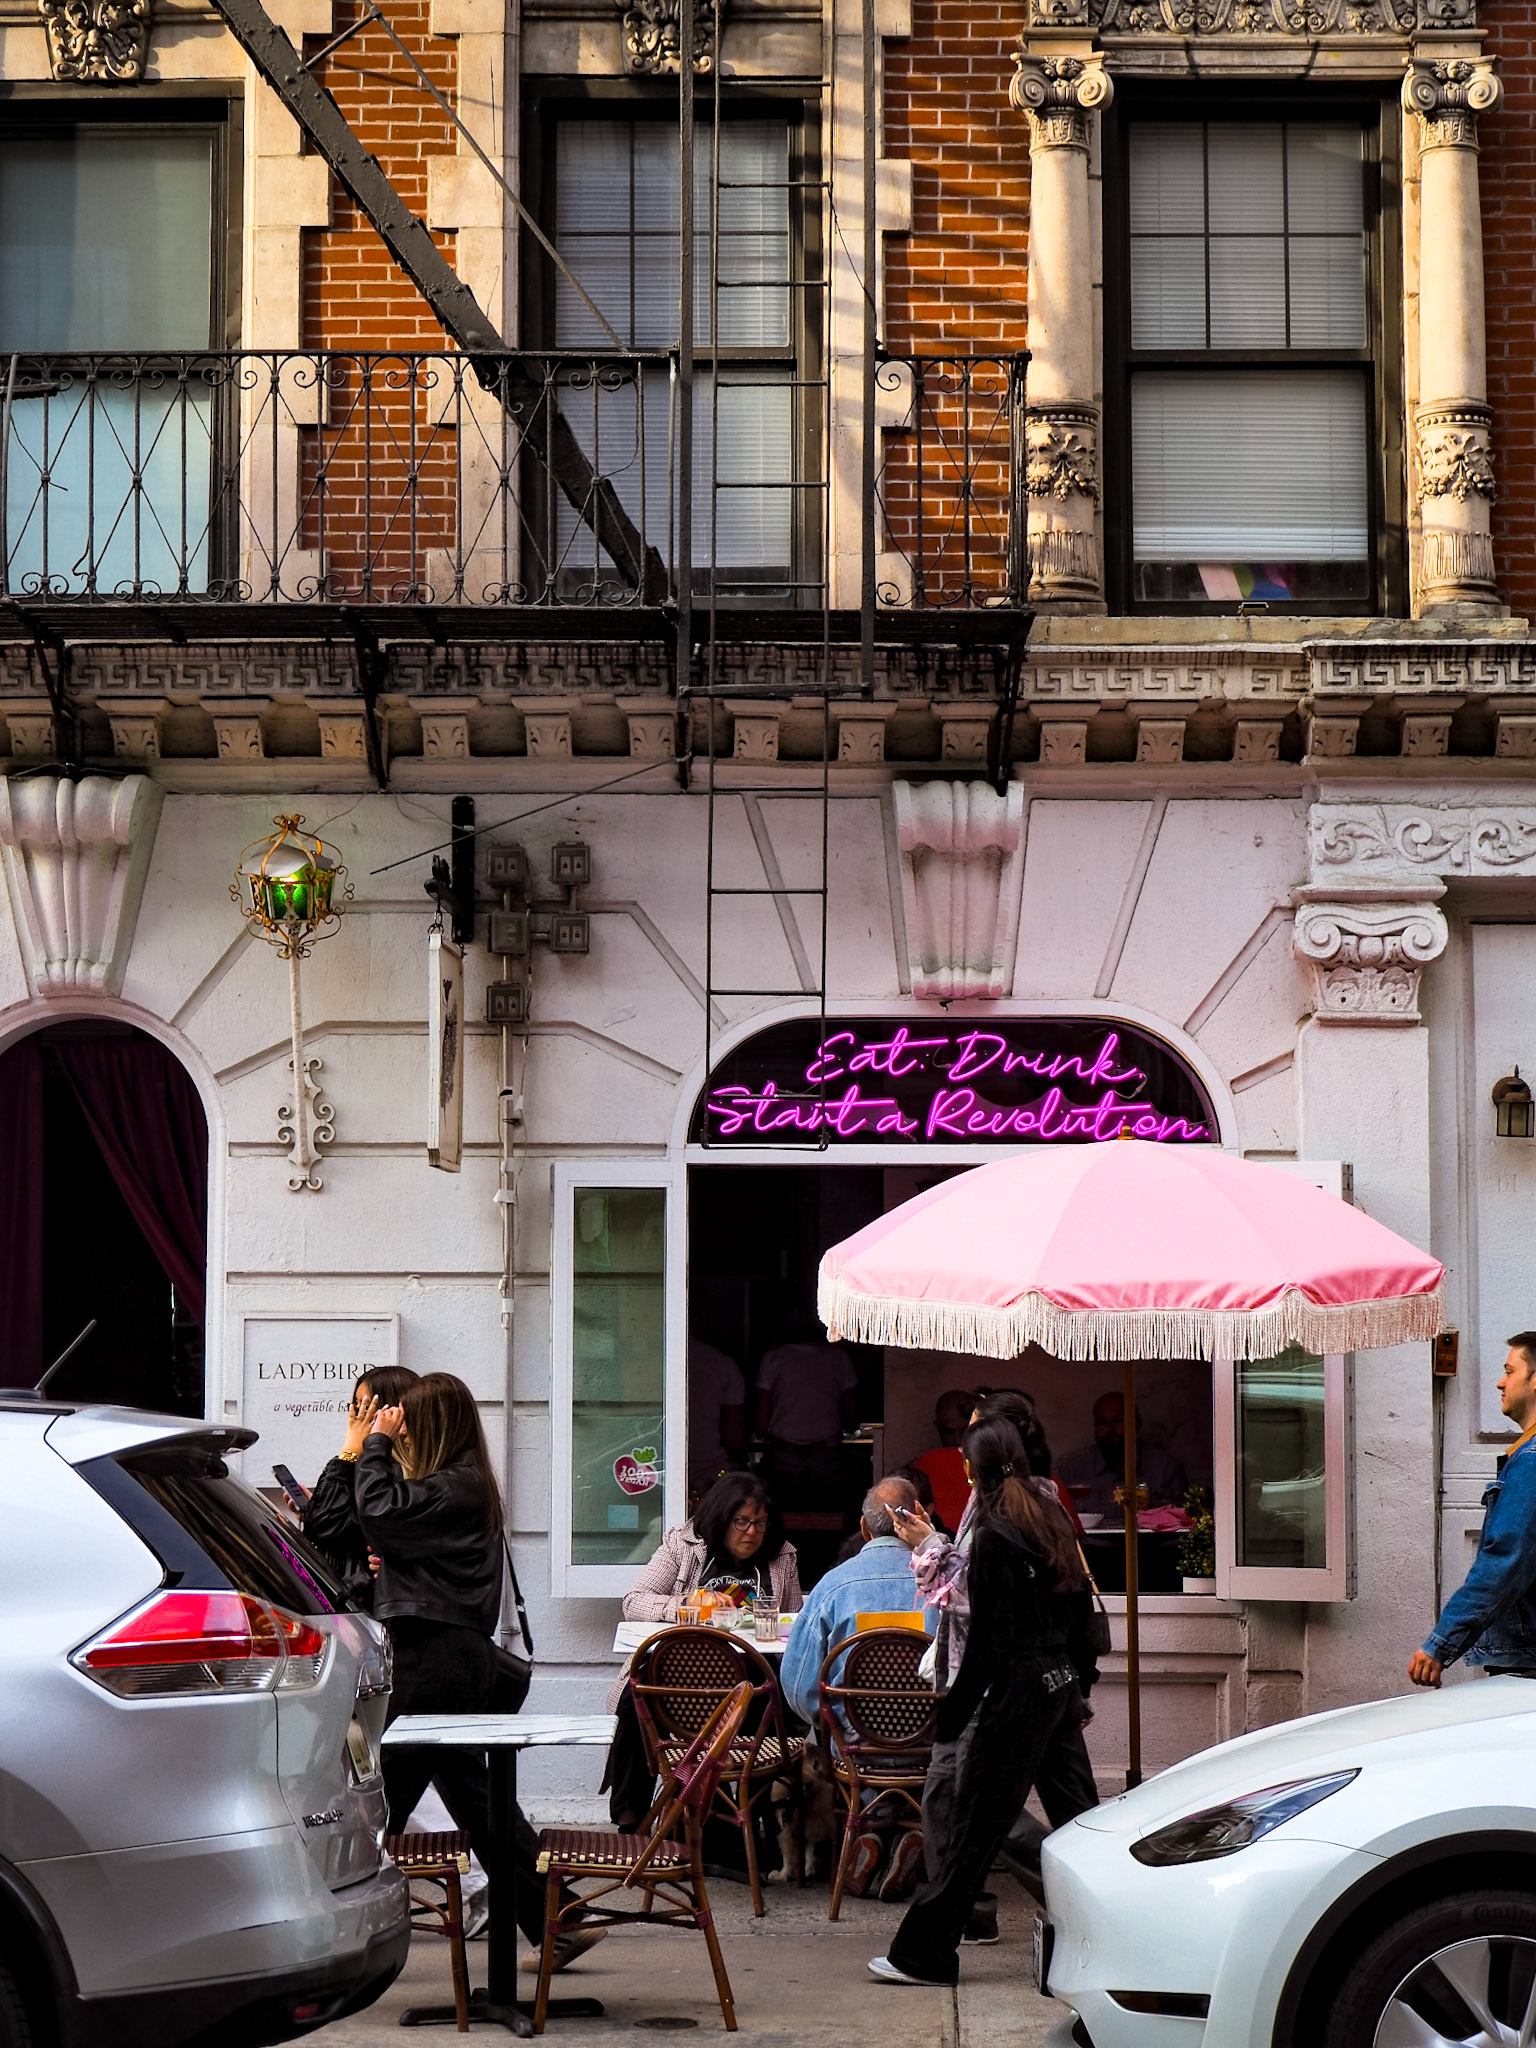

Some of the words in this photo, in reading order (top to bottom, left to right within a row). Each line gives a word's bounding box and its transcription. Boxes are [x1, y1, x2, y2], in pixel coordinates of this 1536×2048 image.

[805, 1027, 949, 1082] Eat.
[949, 1030, 1144, 1085] Drink.
[708, 1082, 896, 1136] Start
[875, 1108, 919, 1134] a
[926, 1086, 1210, 1141] Revolution.
[273, 1403, 281, 1412] a
[337, 1400, 350, 1413] ba
